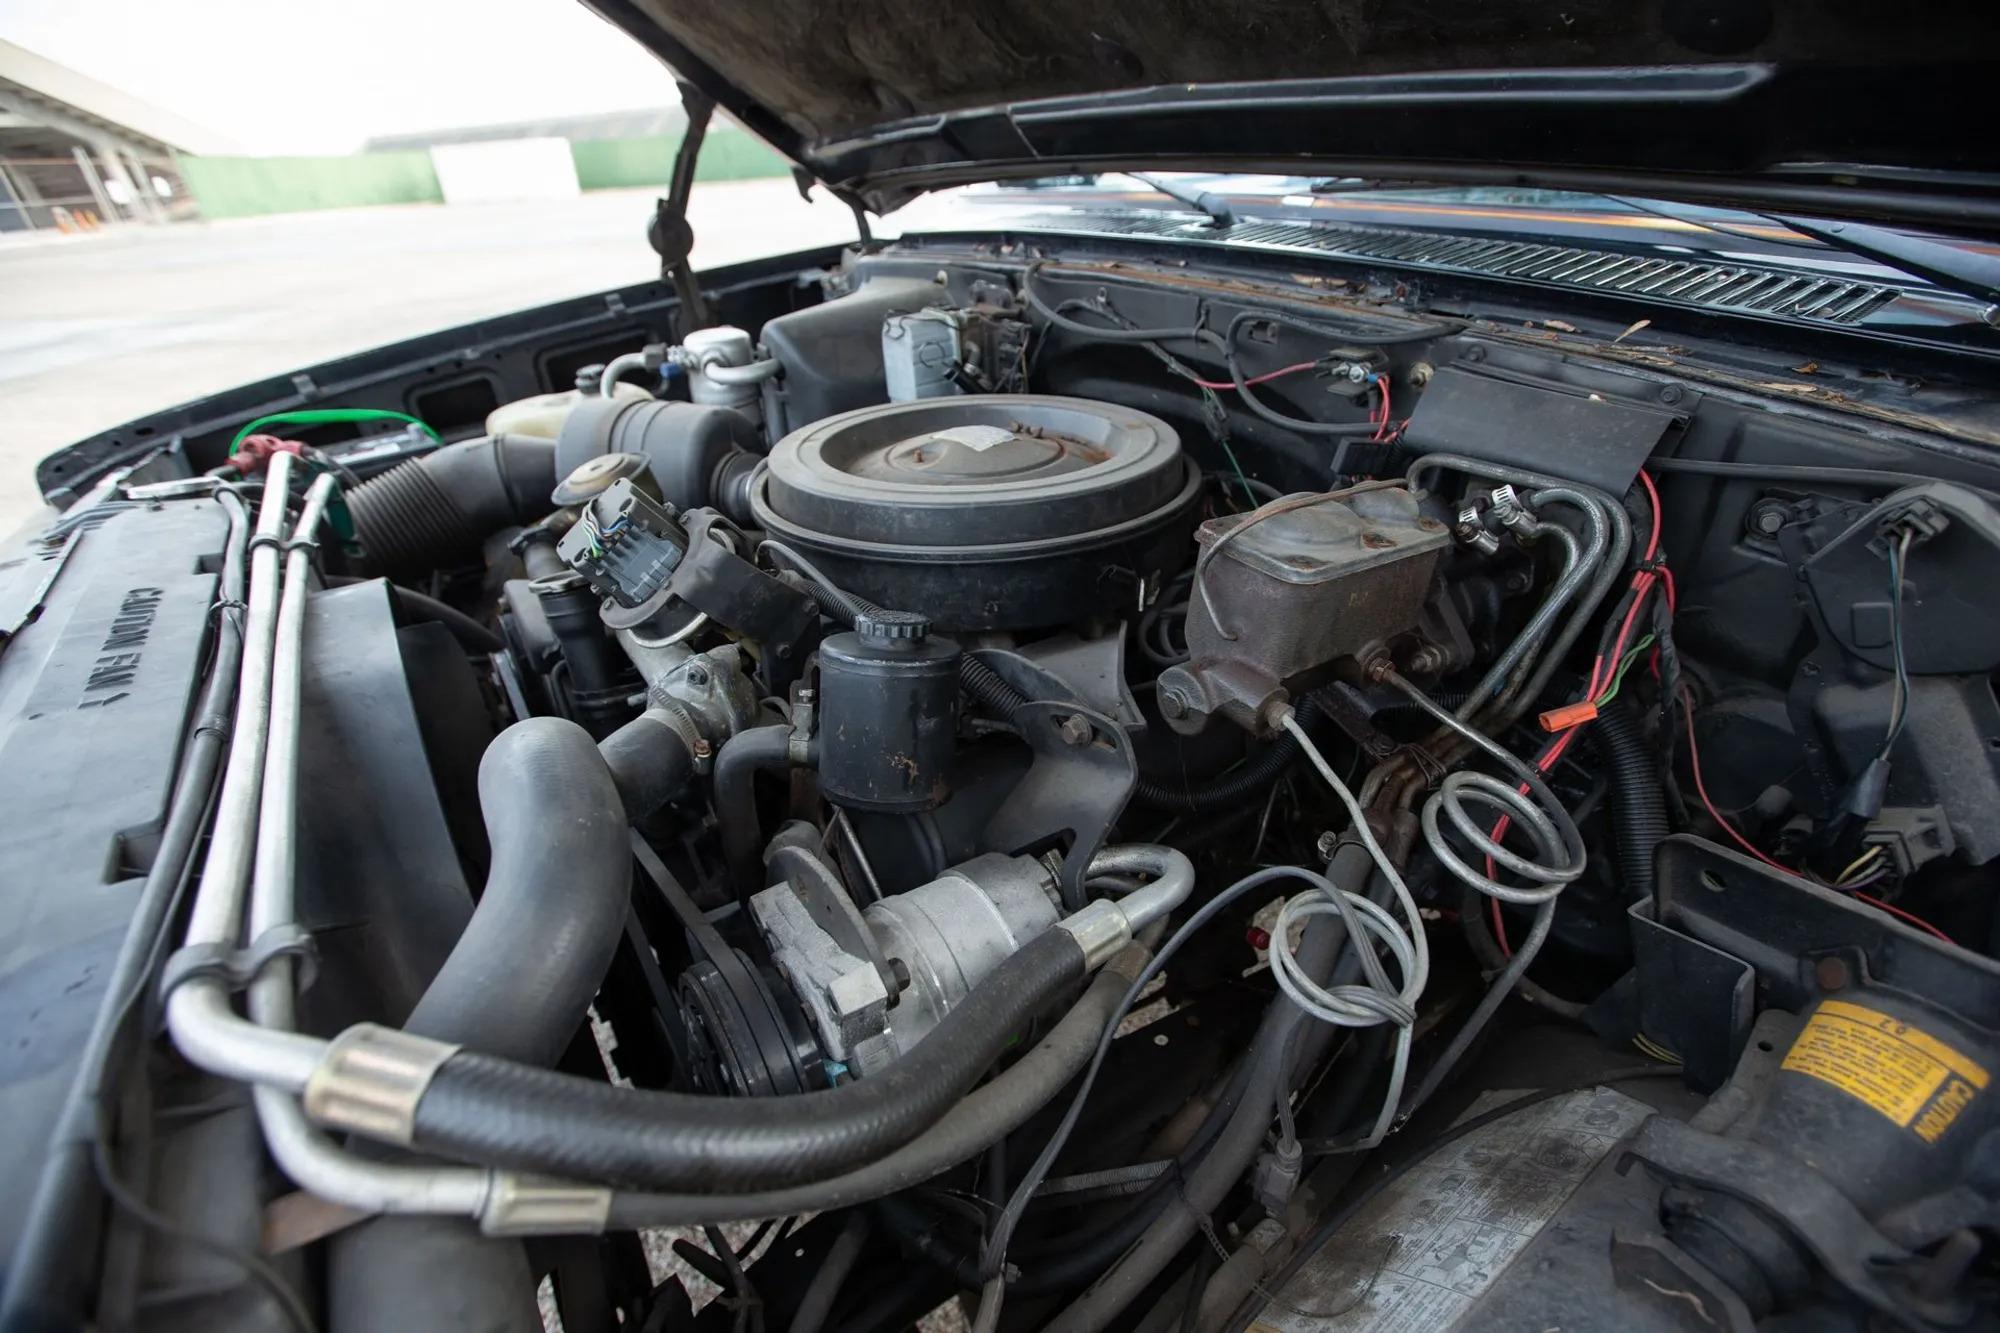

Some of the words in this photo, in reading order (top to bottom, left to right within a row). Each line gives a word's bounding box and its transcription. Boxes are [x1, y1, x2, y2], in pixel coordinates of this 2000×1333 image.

[101, 587, 165, 651] CAUTION
[83, 652, 142, 692] FAN
[1913, 1080, 1976, 1144] CAUTION
